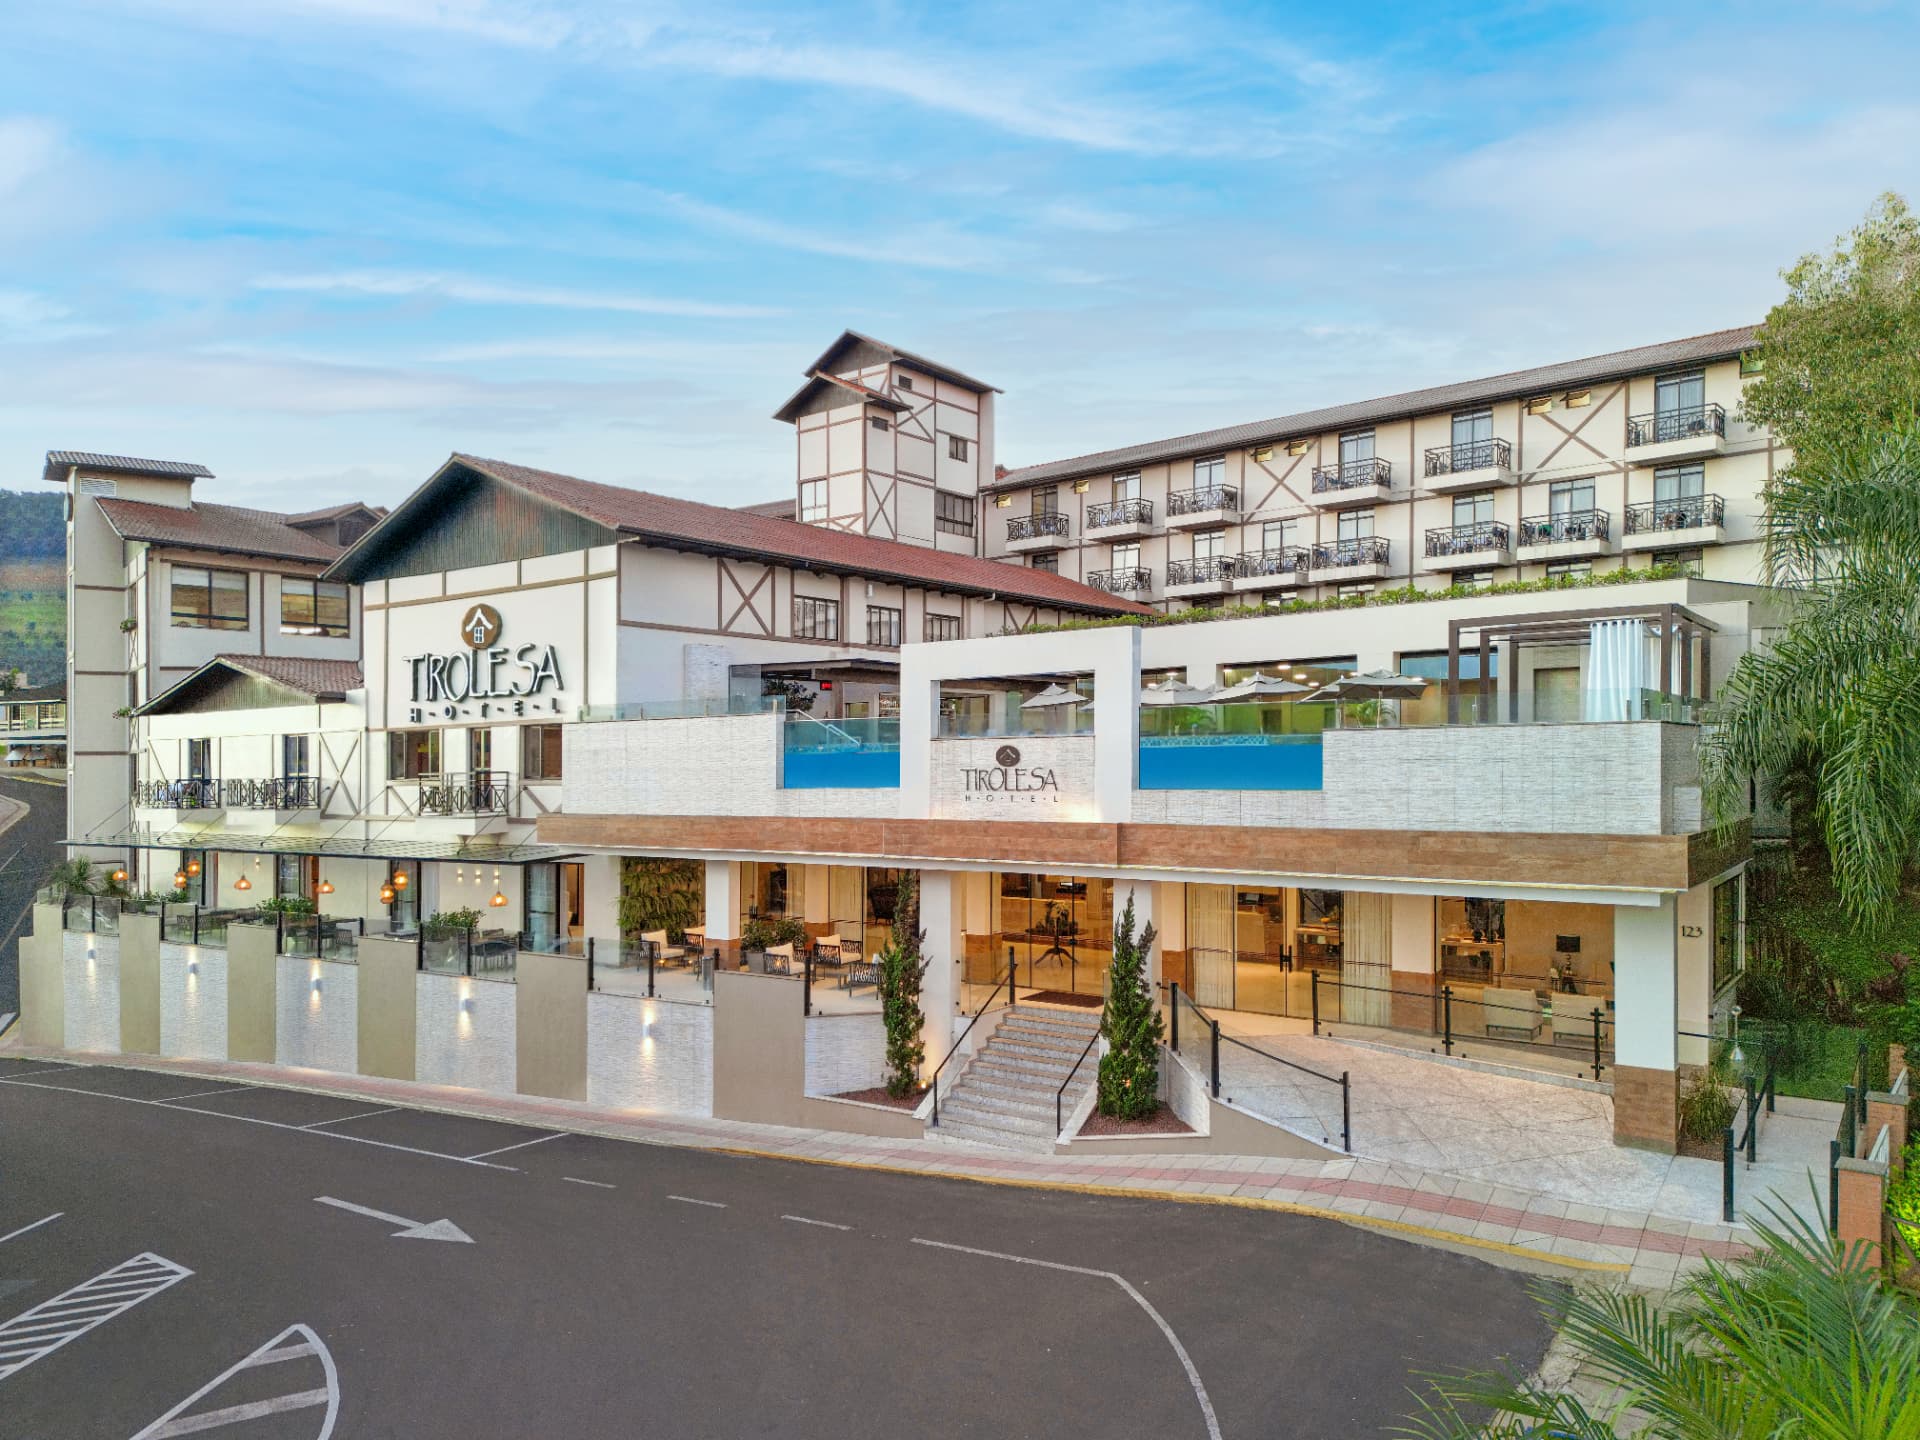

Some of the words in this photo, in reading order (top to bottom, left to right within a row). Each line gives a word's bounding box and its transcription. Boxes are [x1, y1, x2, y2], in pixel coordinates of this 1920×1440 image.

[402, 643, 564, 703] TIROLESA
[960, 767, 1058, 791] TIROLESA
[1682, 925, 1703, 938] 123
